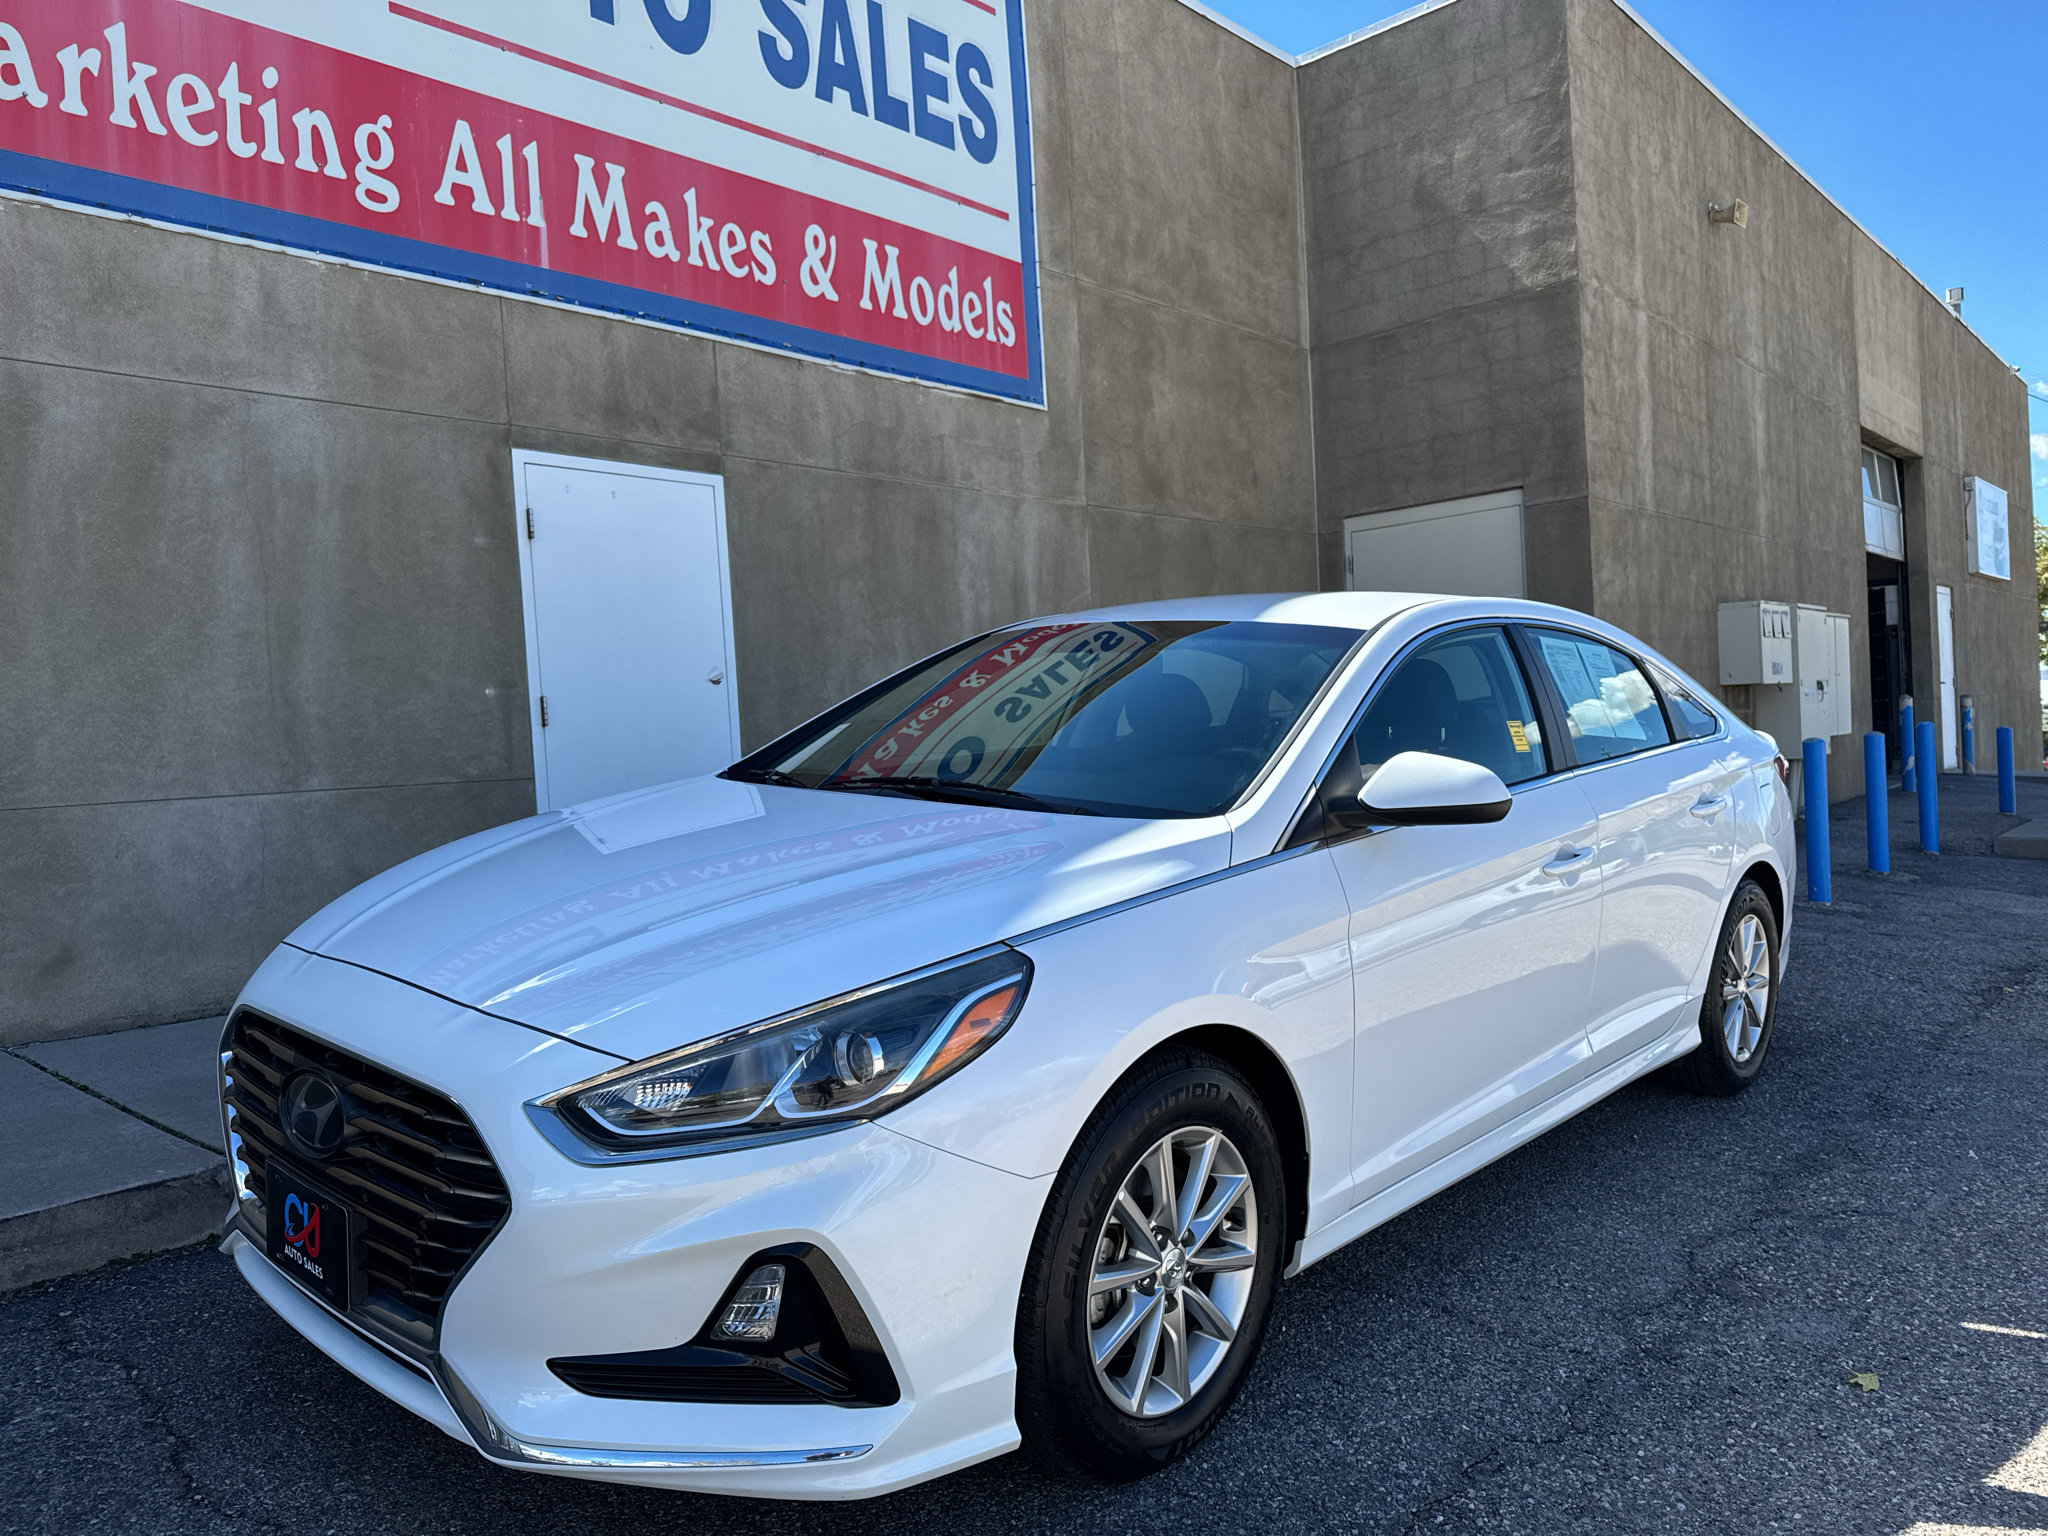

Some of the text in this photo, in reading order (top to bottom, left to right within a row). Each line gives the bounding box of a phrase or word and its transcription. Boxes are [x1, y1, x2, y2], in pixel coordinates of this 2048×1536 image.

[757, 0, 998, 165] SALES
[0, 21, 1017, 348] arketing All Makes & Models
[284, 1243, 324, 1280] AUTO SALES
